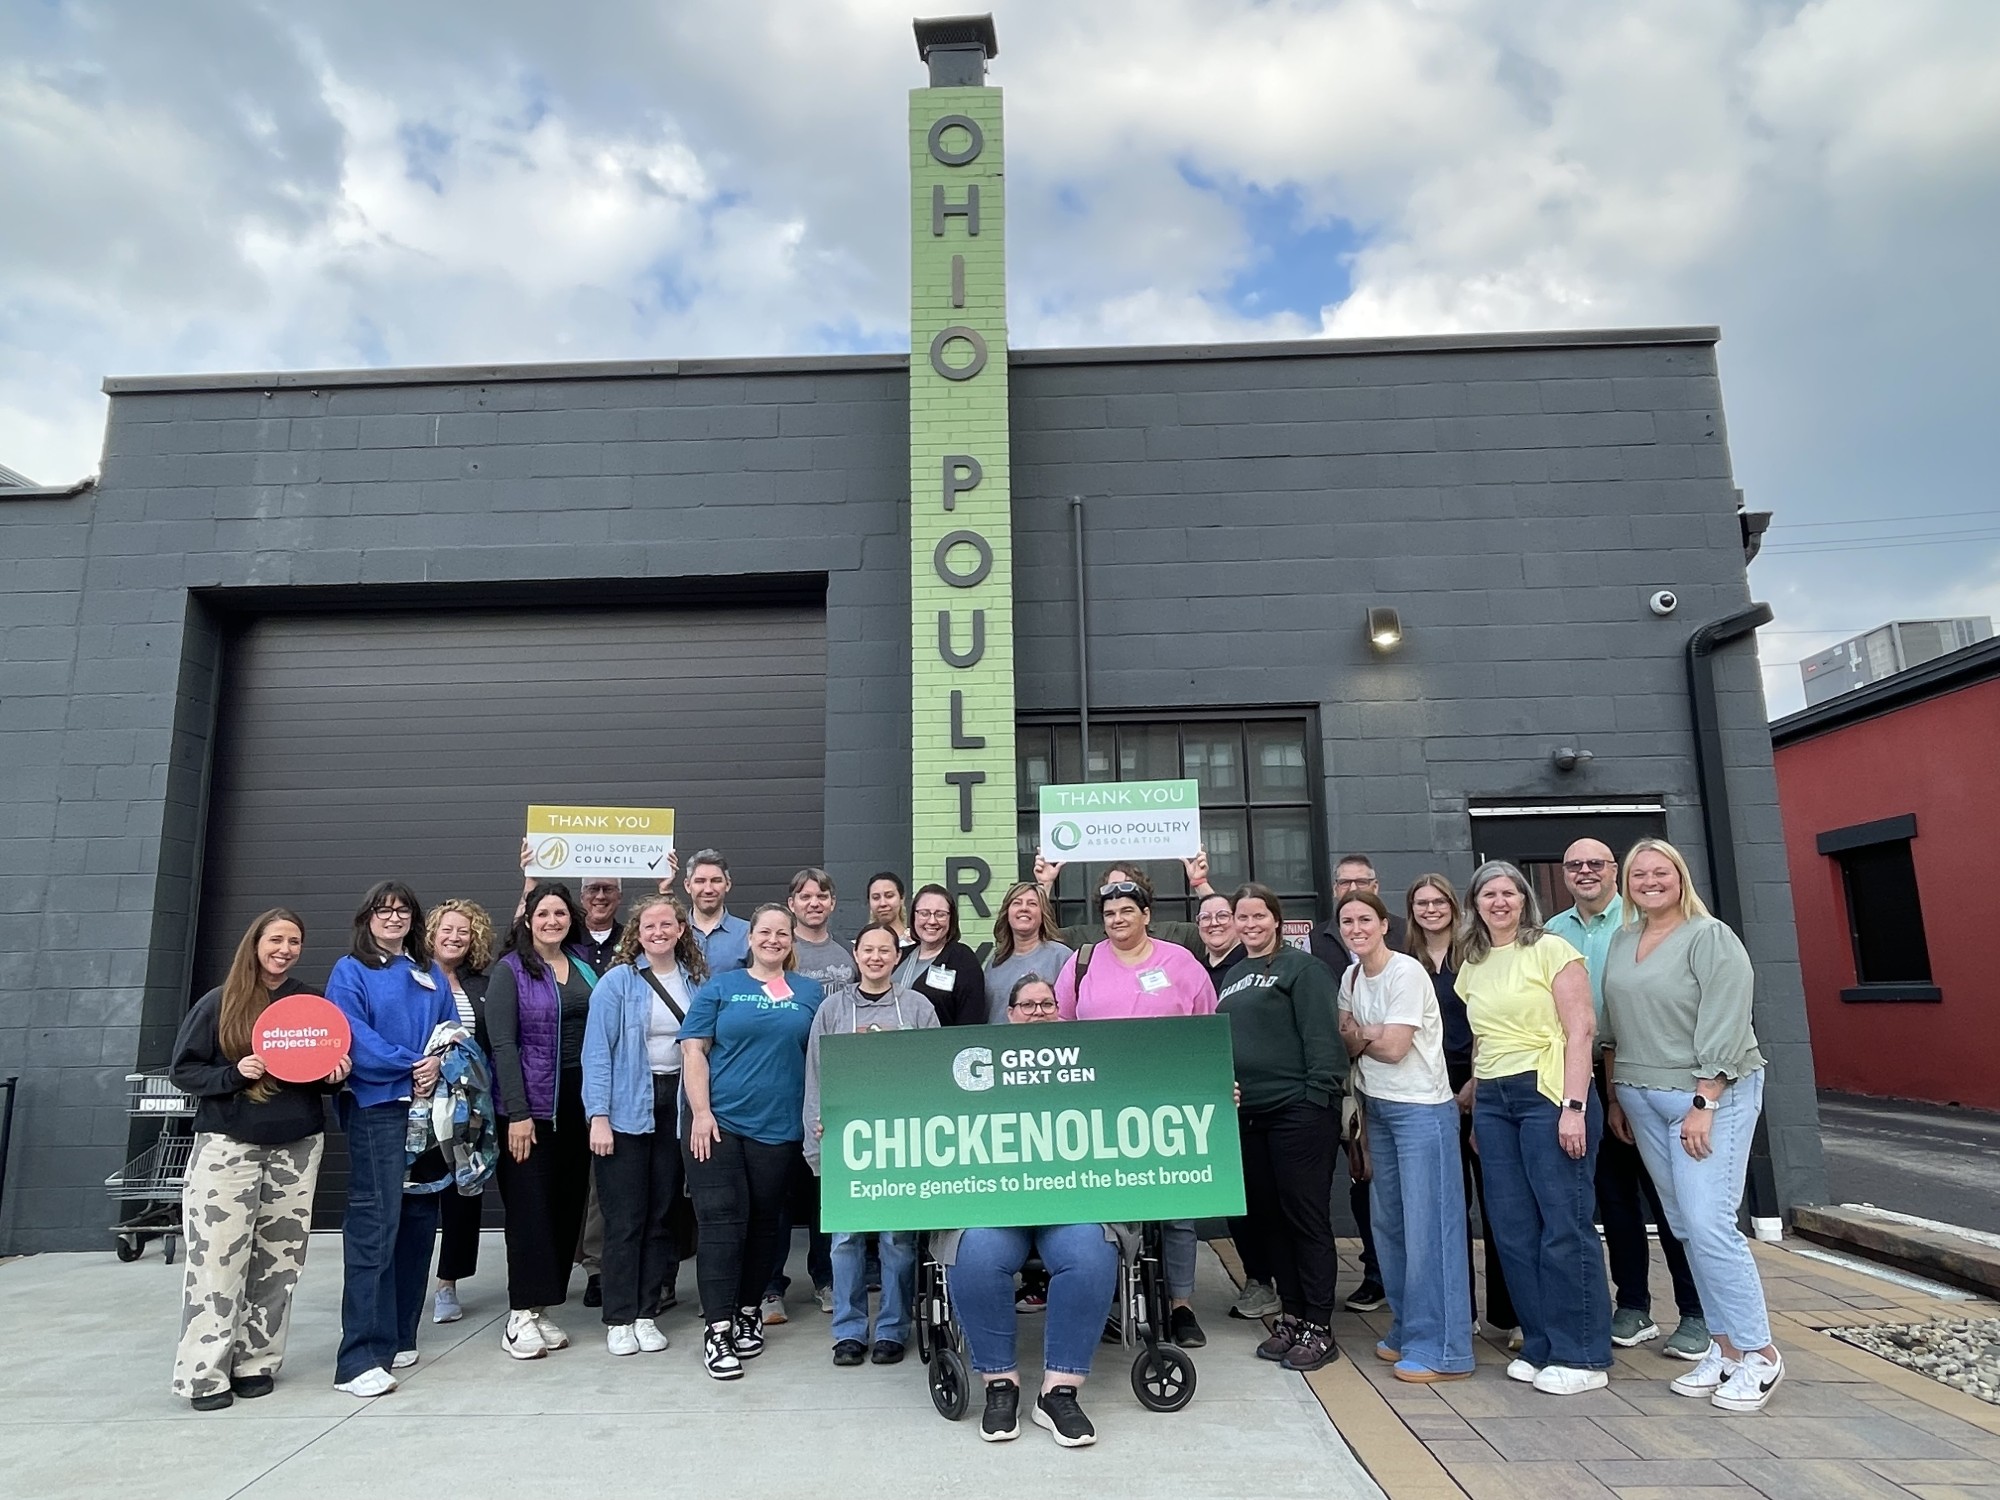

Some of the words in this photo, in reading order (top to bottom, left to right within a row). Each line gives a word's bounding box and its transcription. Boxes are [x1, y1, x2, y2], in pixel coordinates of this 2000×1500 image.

[928, 114, 988, 380] OHIO
[1057, 790, 1132, 806] THANK
[1139, 788, 1184, 803] YOU
[548, 815, 609, 828] THANK
[614, 816, 650, 829] YOU
[1086, 823, 1122, 835] OHIO
[1126, 821, 1191, 834] POULTRY
[1087, 836, 1171, 845] ASSOCIATION
[575, 843, 605, 853] OHIO
[609, 844, 664, 853] SOYBEAN
[575, 856, 635, 864] COUNCIL
[1283, 923, 1310, 934] RNING
[731, 994, 785, 1004] SCIEN
[756, 1002, 769, 1010] IS
[772, 1001, 799, 1010] LIFE
[263, 1027, 328, 1038] education
[263, 1038, 342, 1050] projects.org
[1000, 1047, 1081, 1068] GROW
[952, 1047, 995, 1092] G
[1002, 1069, 1053, 1086] NEXT
[1057, 1067, 1096, 1083] GEN
[842, 1103, 1216, 1171] CHICKENOLOGY
[850, 1179, 917, 1200] Explore
[920, 1176, 997, 1199] genetics
[1000, 1175, 1020, 1192] to
[1023, 1171, 1078, 1191] breed
[1081, 1169, 1112, 1188] the
[1115, 1167, 1156, 1187] best
[1158, 1165, 1213, 1185] brood
